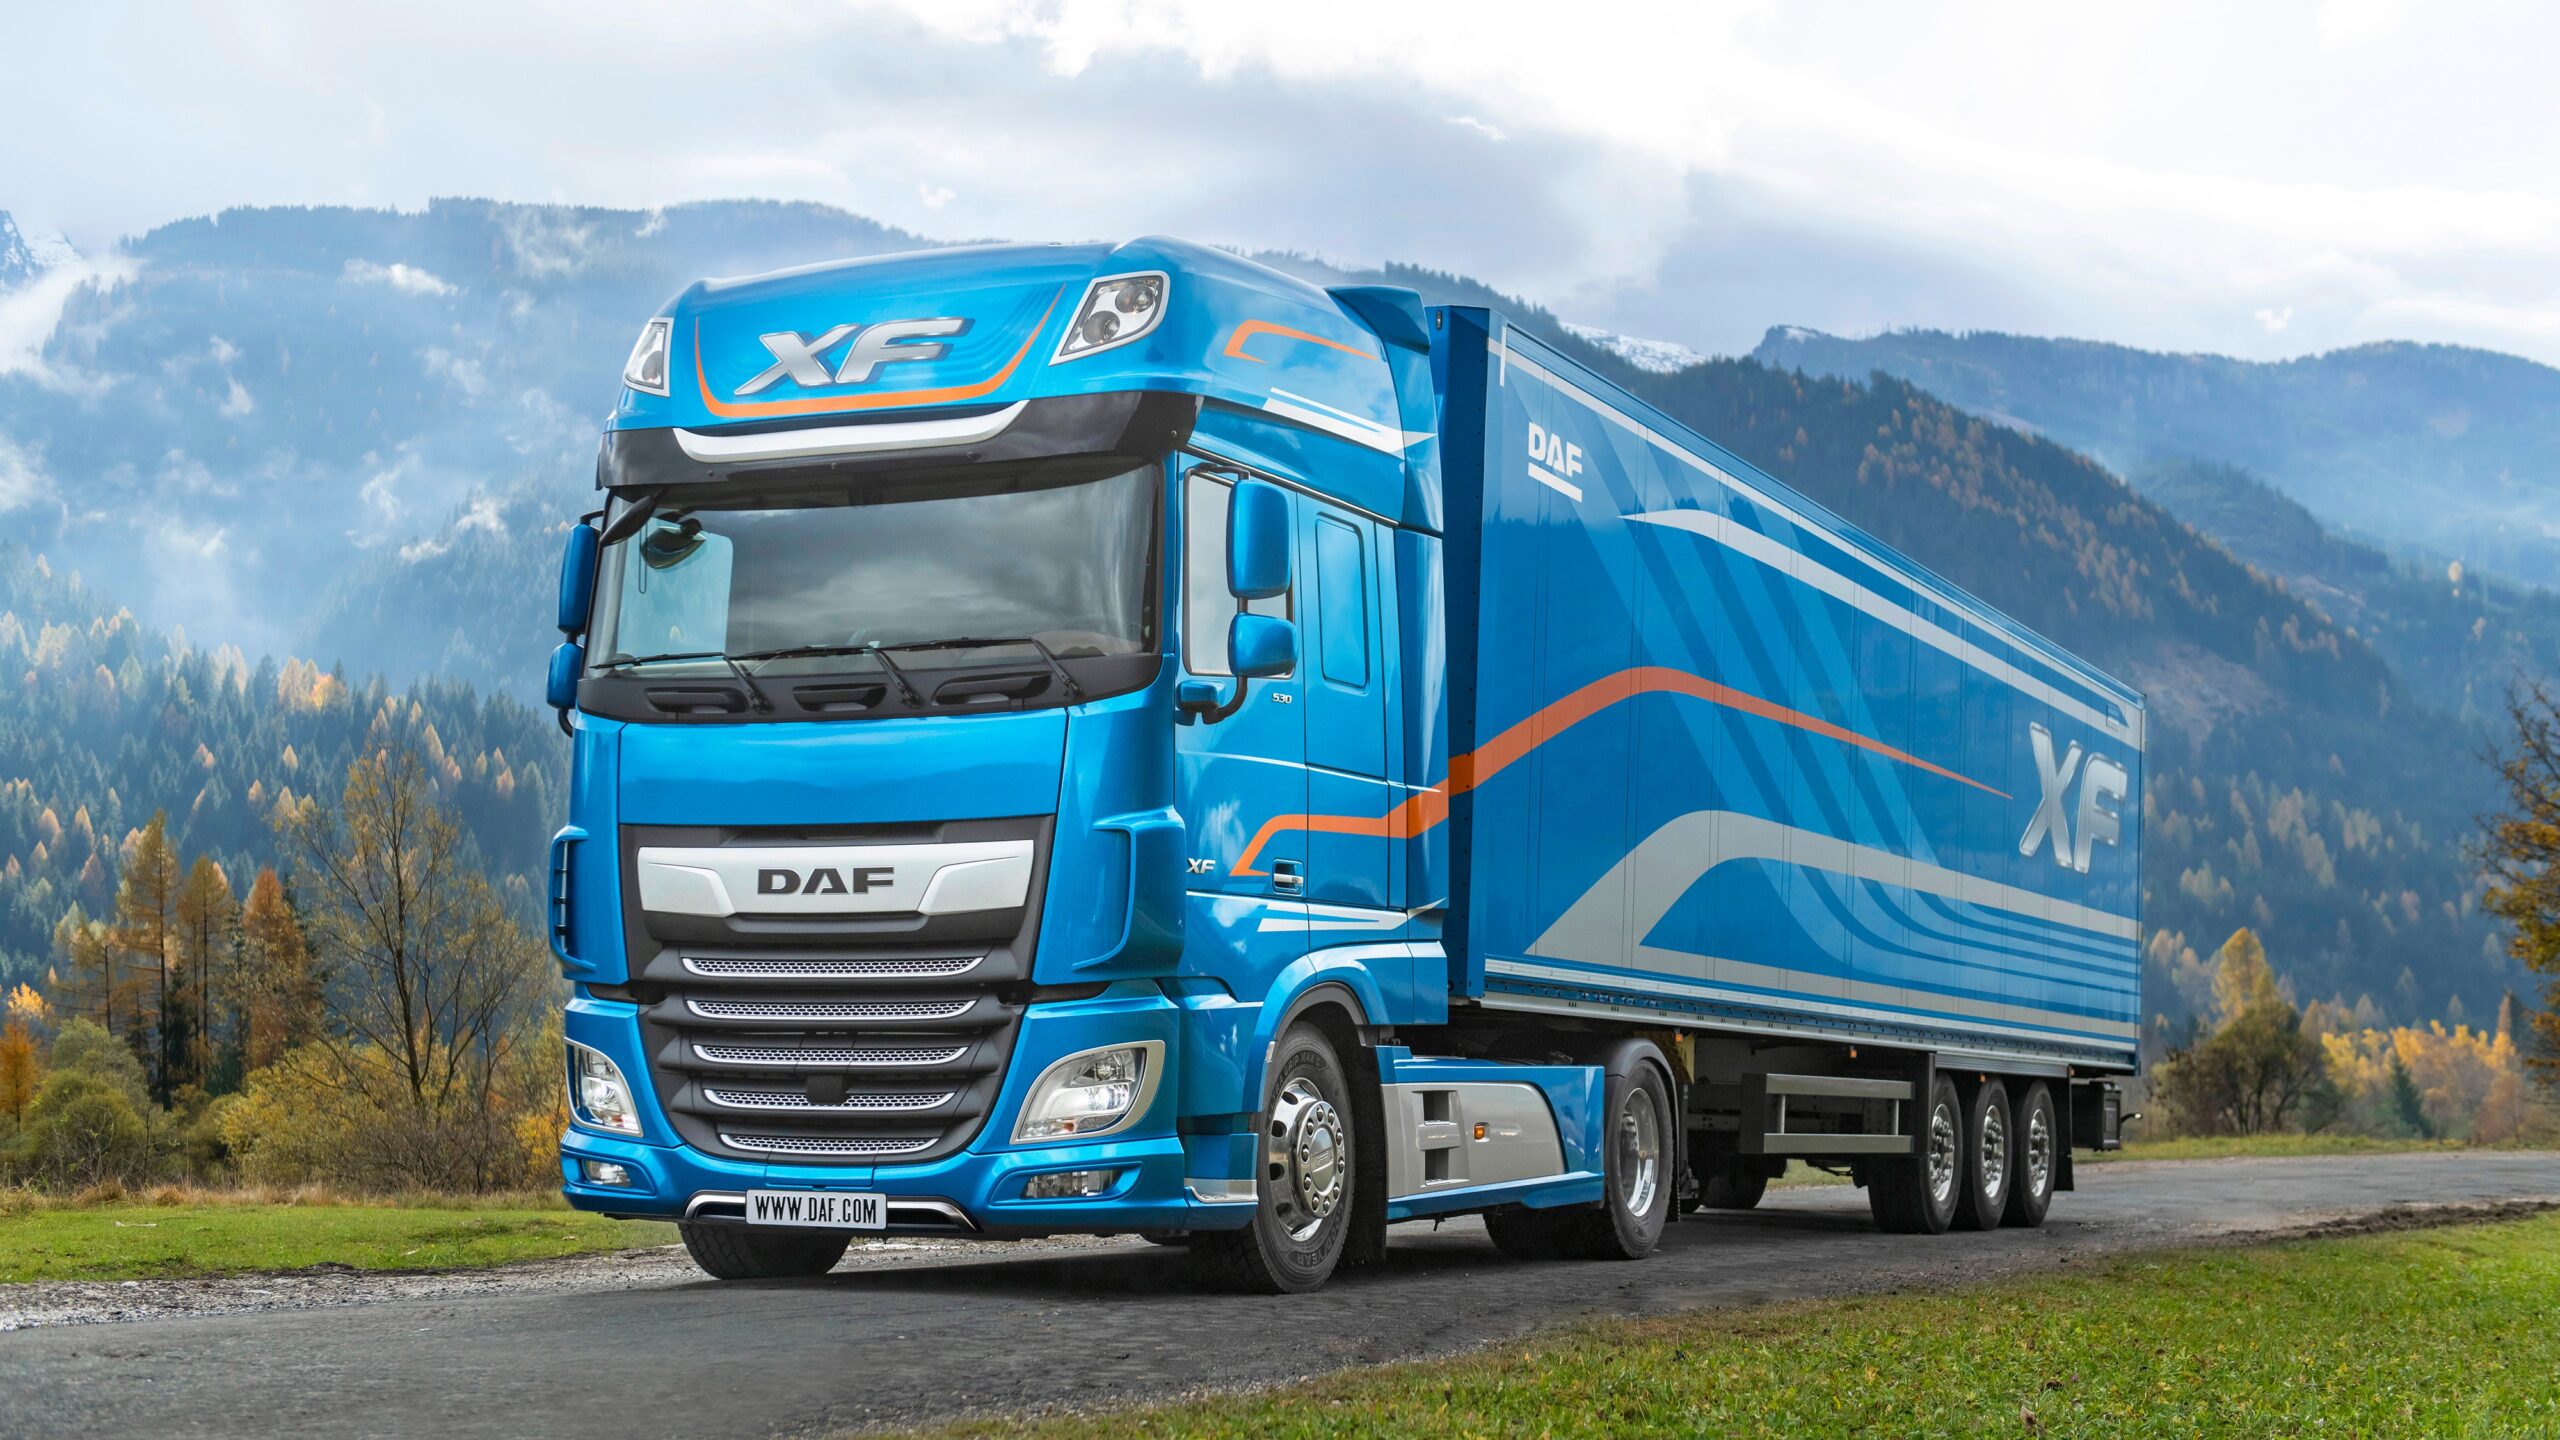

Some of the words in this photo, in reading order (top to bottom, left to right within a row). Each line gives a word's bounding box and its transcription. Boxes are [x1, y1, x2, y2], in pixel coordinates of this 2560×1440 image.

[734, 317, 966, 395] XF
[1528, 421, 1582, 477] DAF
[1272, 692, 1292, 704] 530
[2019, 721, 2128, 874] XF
[1186, 857, 1216, 874] XF
[757, 866, 894, 895] DAF
[1284, 1054, 1299, 1076] GRIP
[755, 1195, 876, 1224] WWW.DAF.COM
